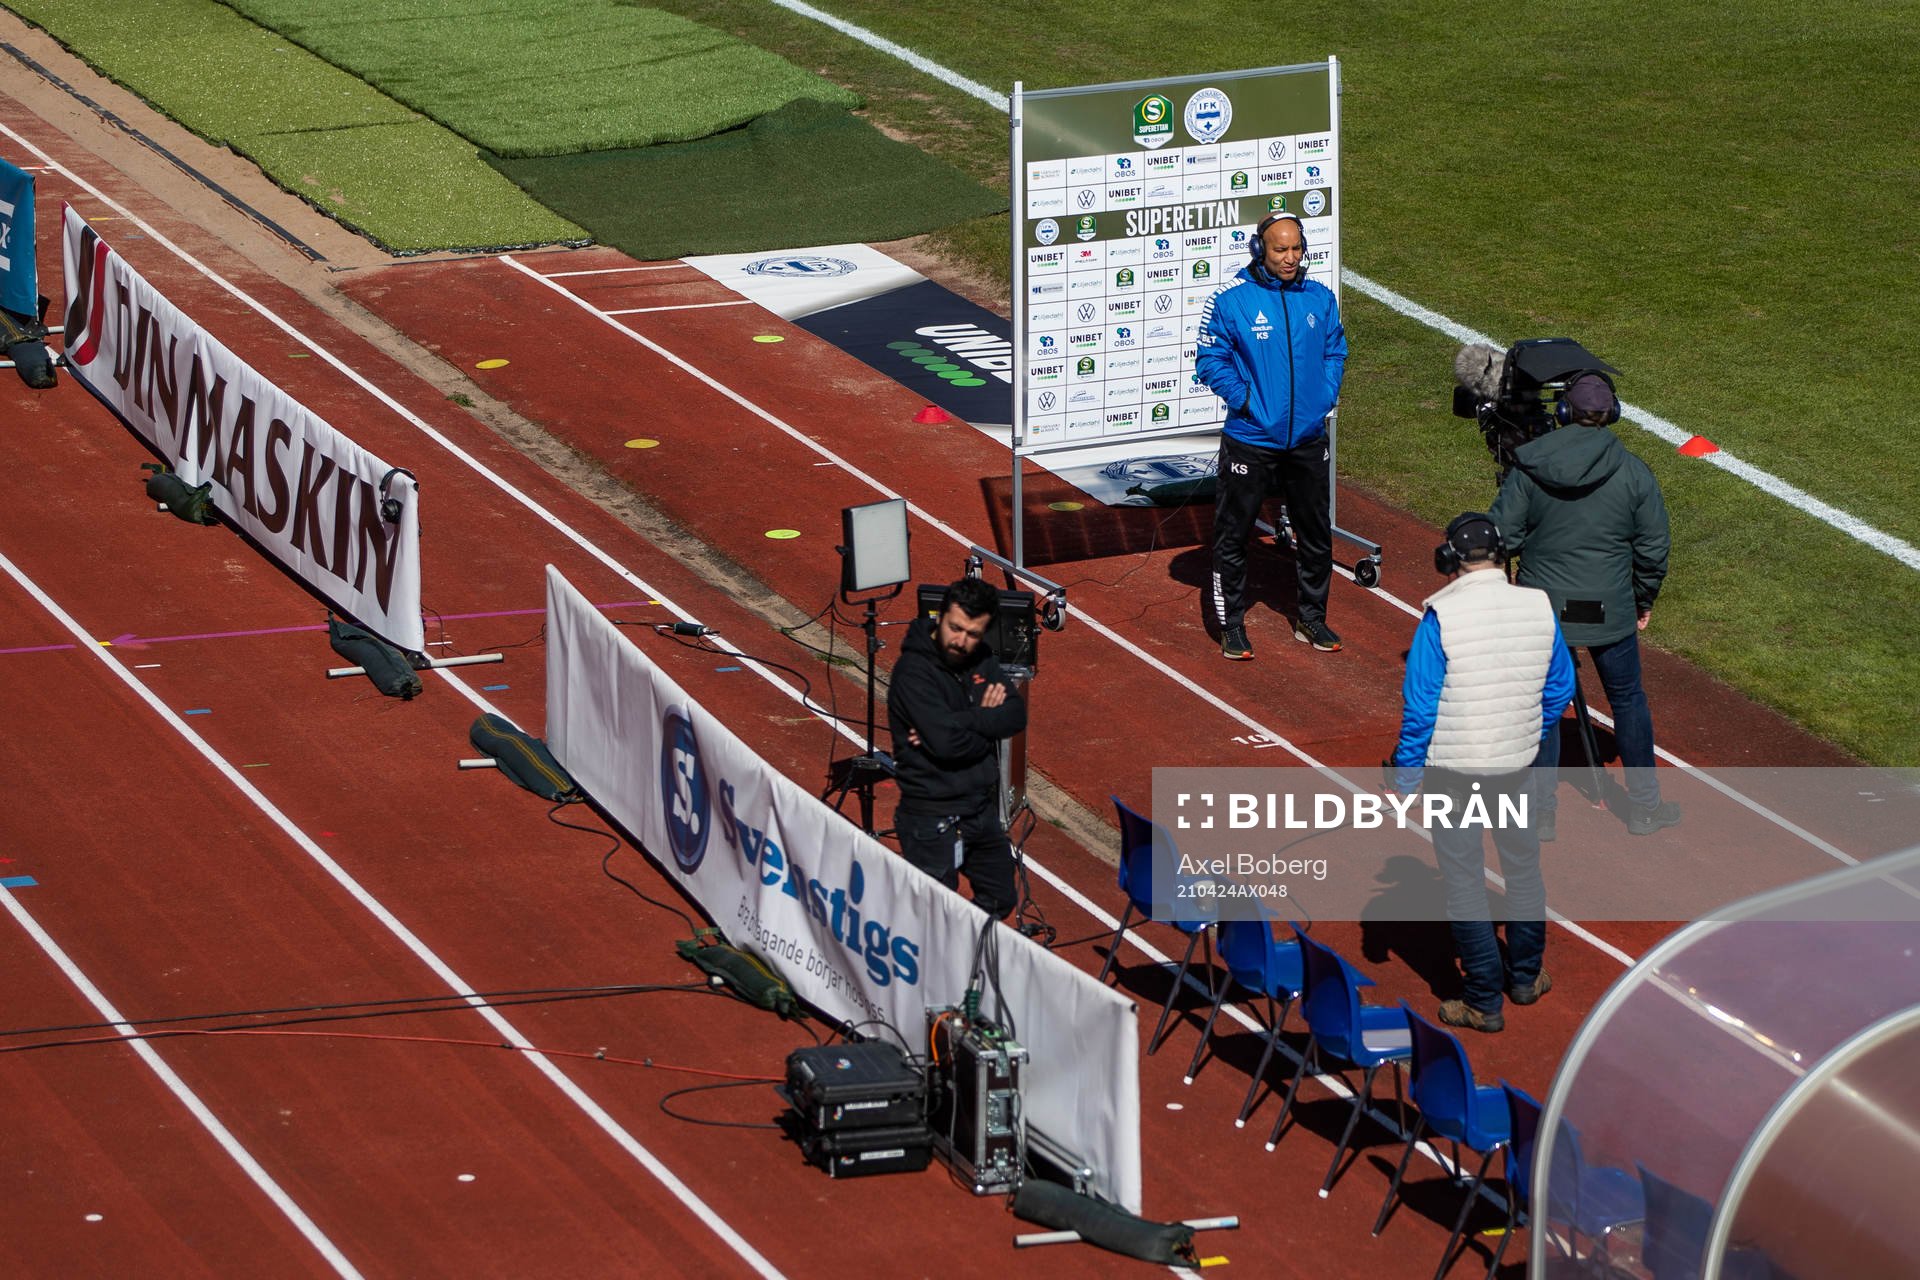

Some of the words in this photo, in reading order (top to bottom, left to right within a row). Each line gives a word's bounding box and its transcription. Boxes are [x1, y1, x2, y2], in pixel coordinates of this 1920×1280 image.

[1199, 101, 1217, 110] IFK
[1138, 123, 1169, 133] SUPERETTAN
[1298, 139, 1330, 150] UNIBET
[1147, 155, 1180, 166] UNIBET
[1115, 170, 1136, 178] OBOS
[1261, 171, 1293, 182] UNIBET
[1304, 178, 1325, 186] OBOS
[1108, 187, 1142, 198] UNIBET
[1126, 199, 1240, 237] SUPERETTAN
[1185, 236, 1218, 247] UNIBET
[1229, 242, 1250, 251] OBOS
[1031, 252, 1064, 263] UNIBET
[1080, 250, 1092, 258] 3M
[1153, 250, 1174, 259] OBOS
[1147, 268, 1180, 279] UNIBET
[1108, 301, 1142, 312] UNIBET
[1070, 333, 1103, 344] UNIBET
[1114, 339, 1136, 348] OBOS
[915, 323, 1012, 384] UNIB
[1036, 347, 1059, 356] OBOS
[1030, 365, 1064, 376] UNIBET
[1145, 380, 1178, 391] UNIBET
[1188, 385, 1210, 394] OBOS
[1106, 411, 1139, 423] UNIBET
[113, 279, 403, 616] DINMASKIN
[1231, 462, 1249, 475] KS
[719, 777, 920, 988] Svenstigs
[806, 948, 844, 992] börjar
